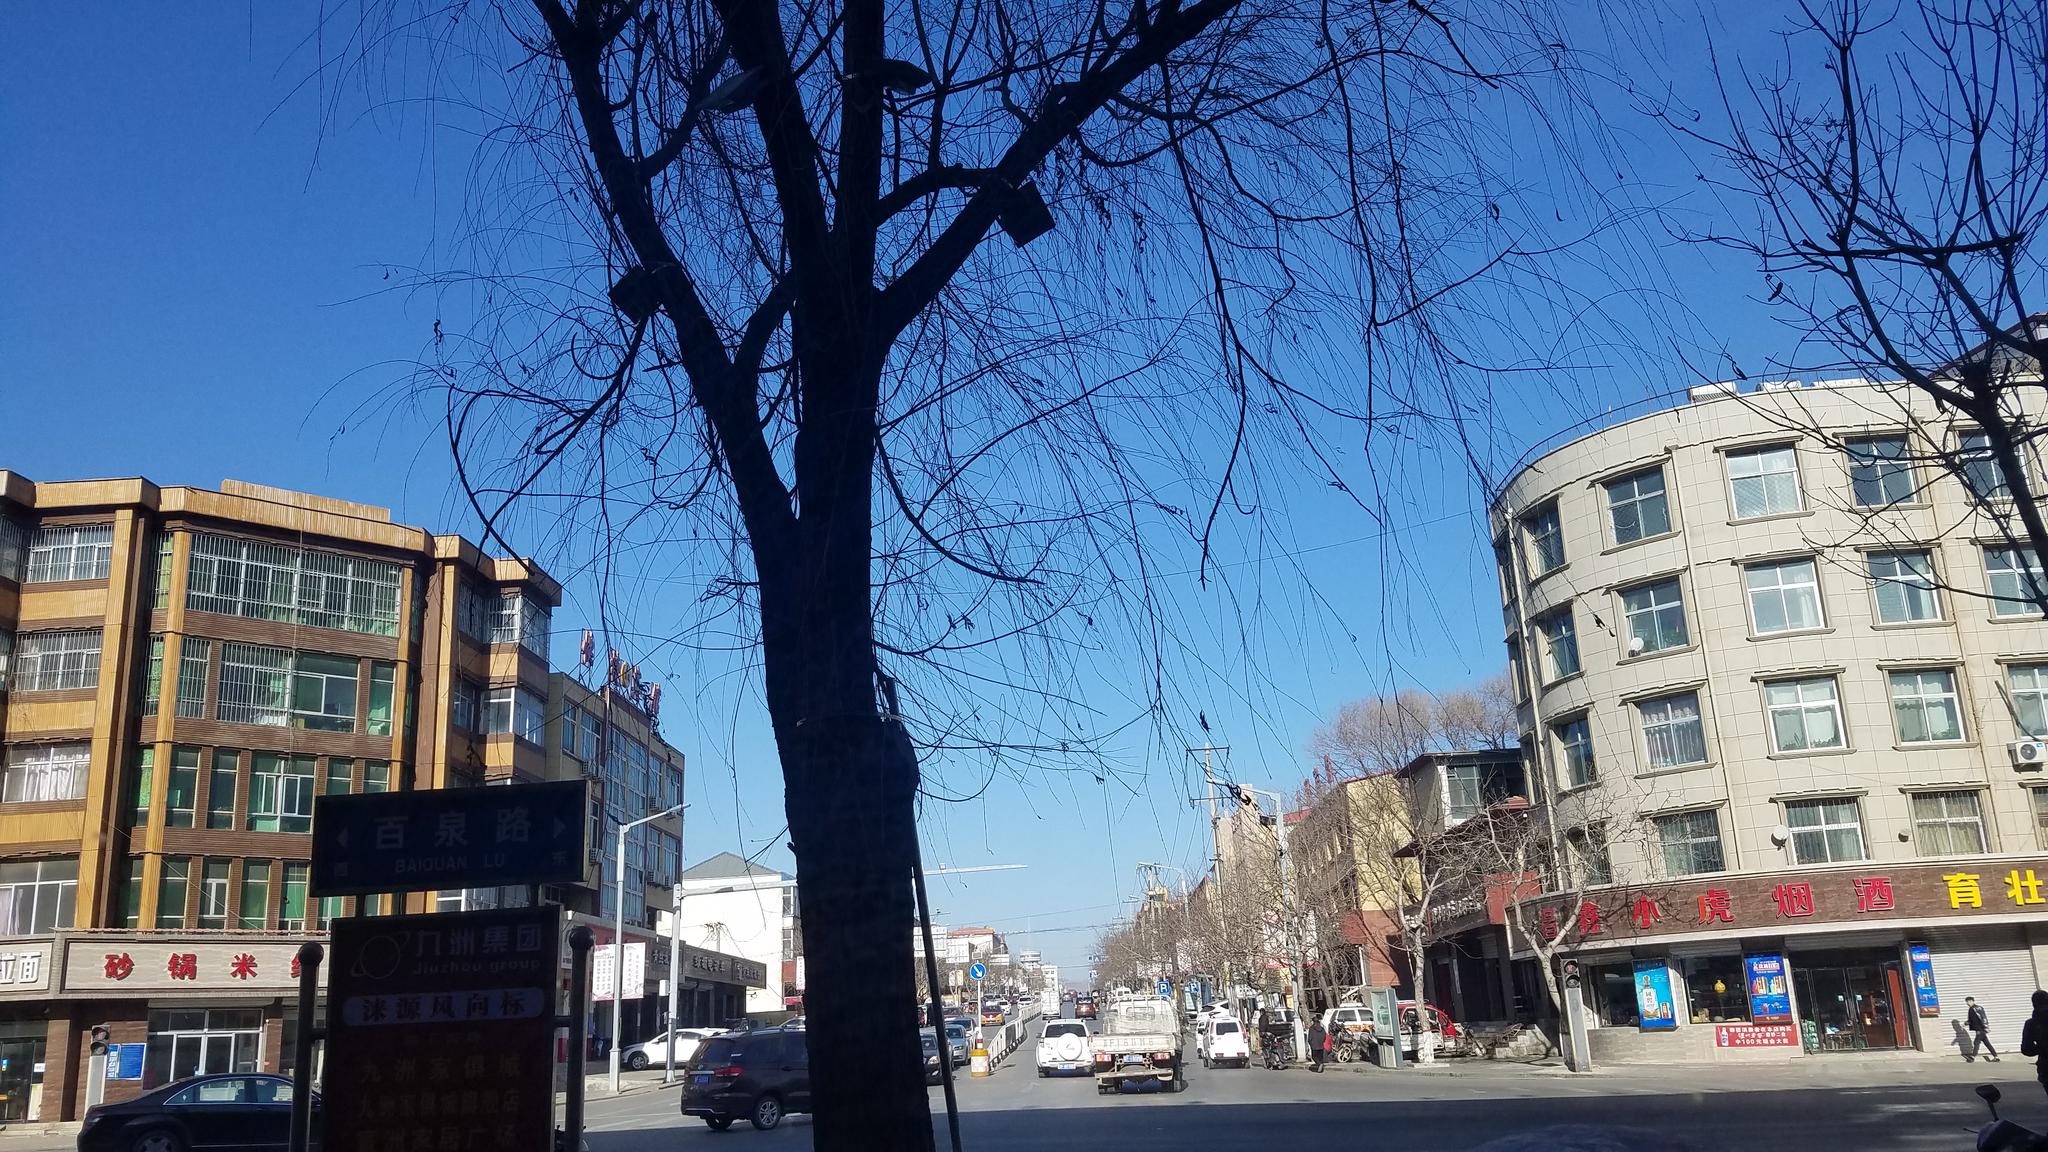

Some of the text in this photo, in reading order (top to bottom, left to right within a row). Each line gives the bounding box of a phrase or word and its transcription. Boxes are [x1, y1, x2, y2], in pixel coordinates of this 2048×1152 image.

[374, 806, 531, 851] 百泉路
[394, 853, 505, 873] BAIQUAN LU
[1943, 869, 2046, 909] 育壮
[413, 959, 541, 975] Jiuzhou group
